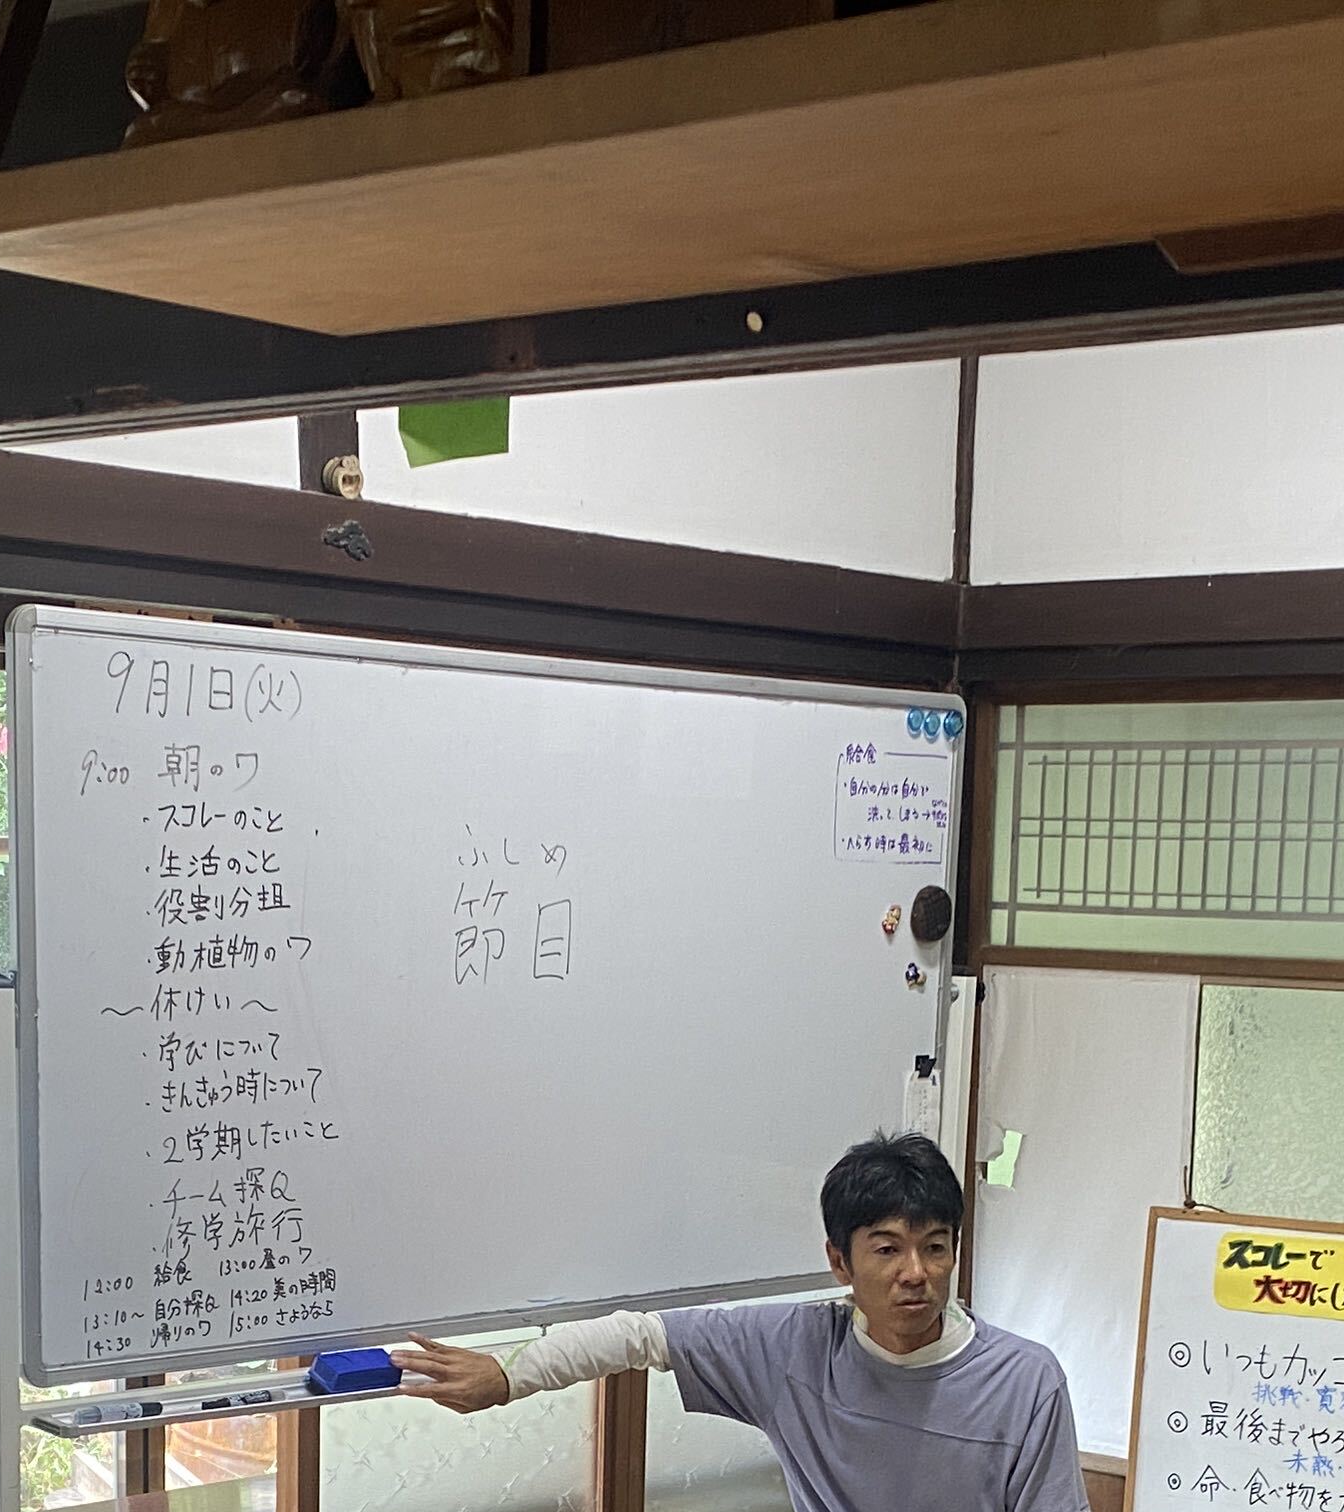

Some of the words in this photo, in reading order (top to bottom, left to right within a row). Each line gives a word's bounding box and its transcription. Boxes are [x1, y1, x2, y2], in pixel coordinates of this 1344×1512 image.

[107, 651, 303, 722] 9月1日(火)
[158, 804, 284, 833] スコレーのこと
[160, 845, 281, 879] 生活のこと
[458, 824, 568, 876] ふしめ
[454, 882, 572, 985] 節目
[158, 1033, 280, 1071] 学びについて
[161, 1067, 322, 1113] きんきゅう時について
[162, 1119, 340, 1164] 2学期したいこと
[162, 1208, 305, 1260] 修学旅行
[1223, 1239, 1335, 1271] スコレーで
[84, 1276, 133, 1300] 12:00
[153, 1258, 192, 1286] 給食
[220, 1259, 255, 1276] 13:00
[231, 1289, 268, 1307] 14:20
[87, 1337, 131, 1358] 14:30
[230, 1312, 268, 1337] 15:00
[276, 1300, 334, 1326] さようなら
